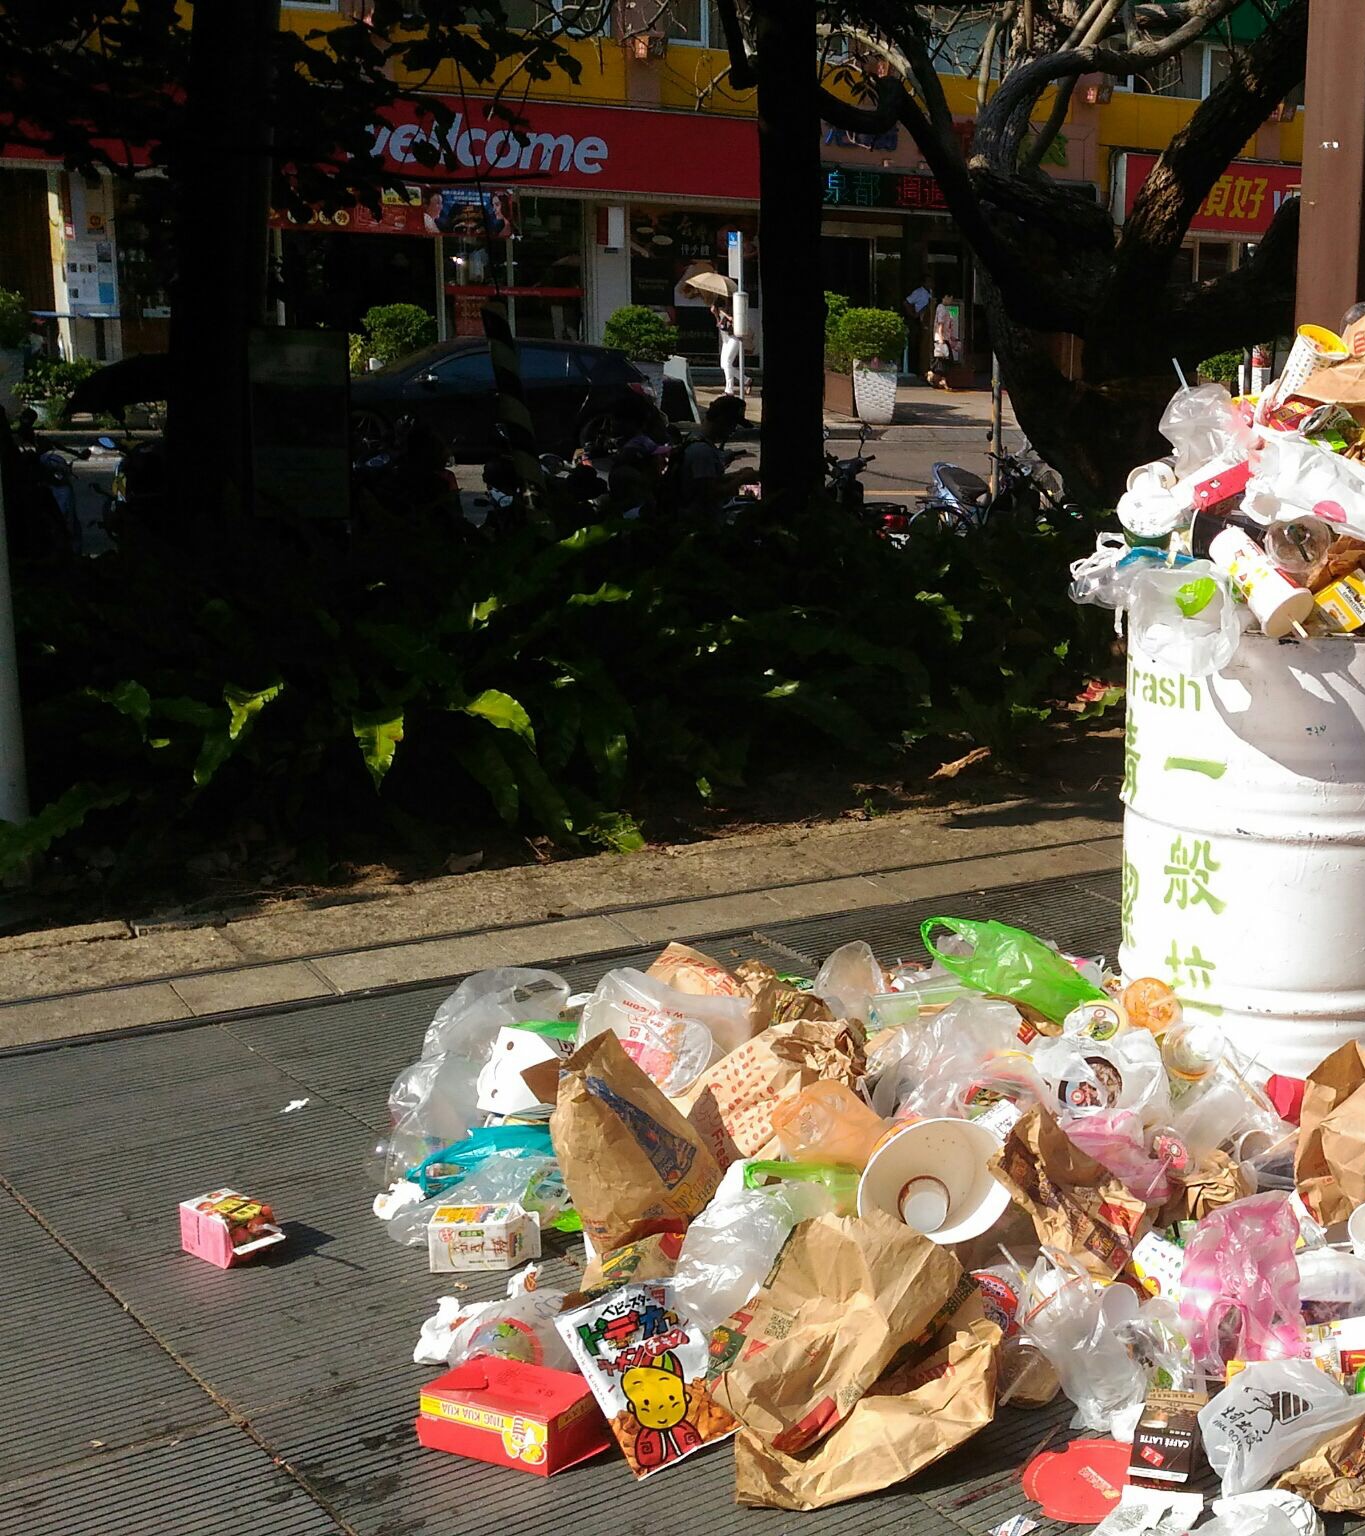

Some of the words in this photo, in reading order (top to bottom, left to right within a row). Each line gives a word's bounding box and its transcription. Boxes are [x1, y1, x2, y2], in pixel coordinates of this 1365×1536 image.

[441, 1402, 461, 1416] KUA
[462, 1408, 481, 1421] KUA
[483, 1415, 505, 1429] TING
[1139, 1434, 1164, 1446] LATTE
